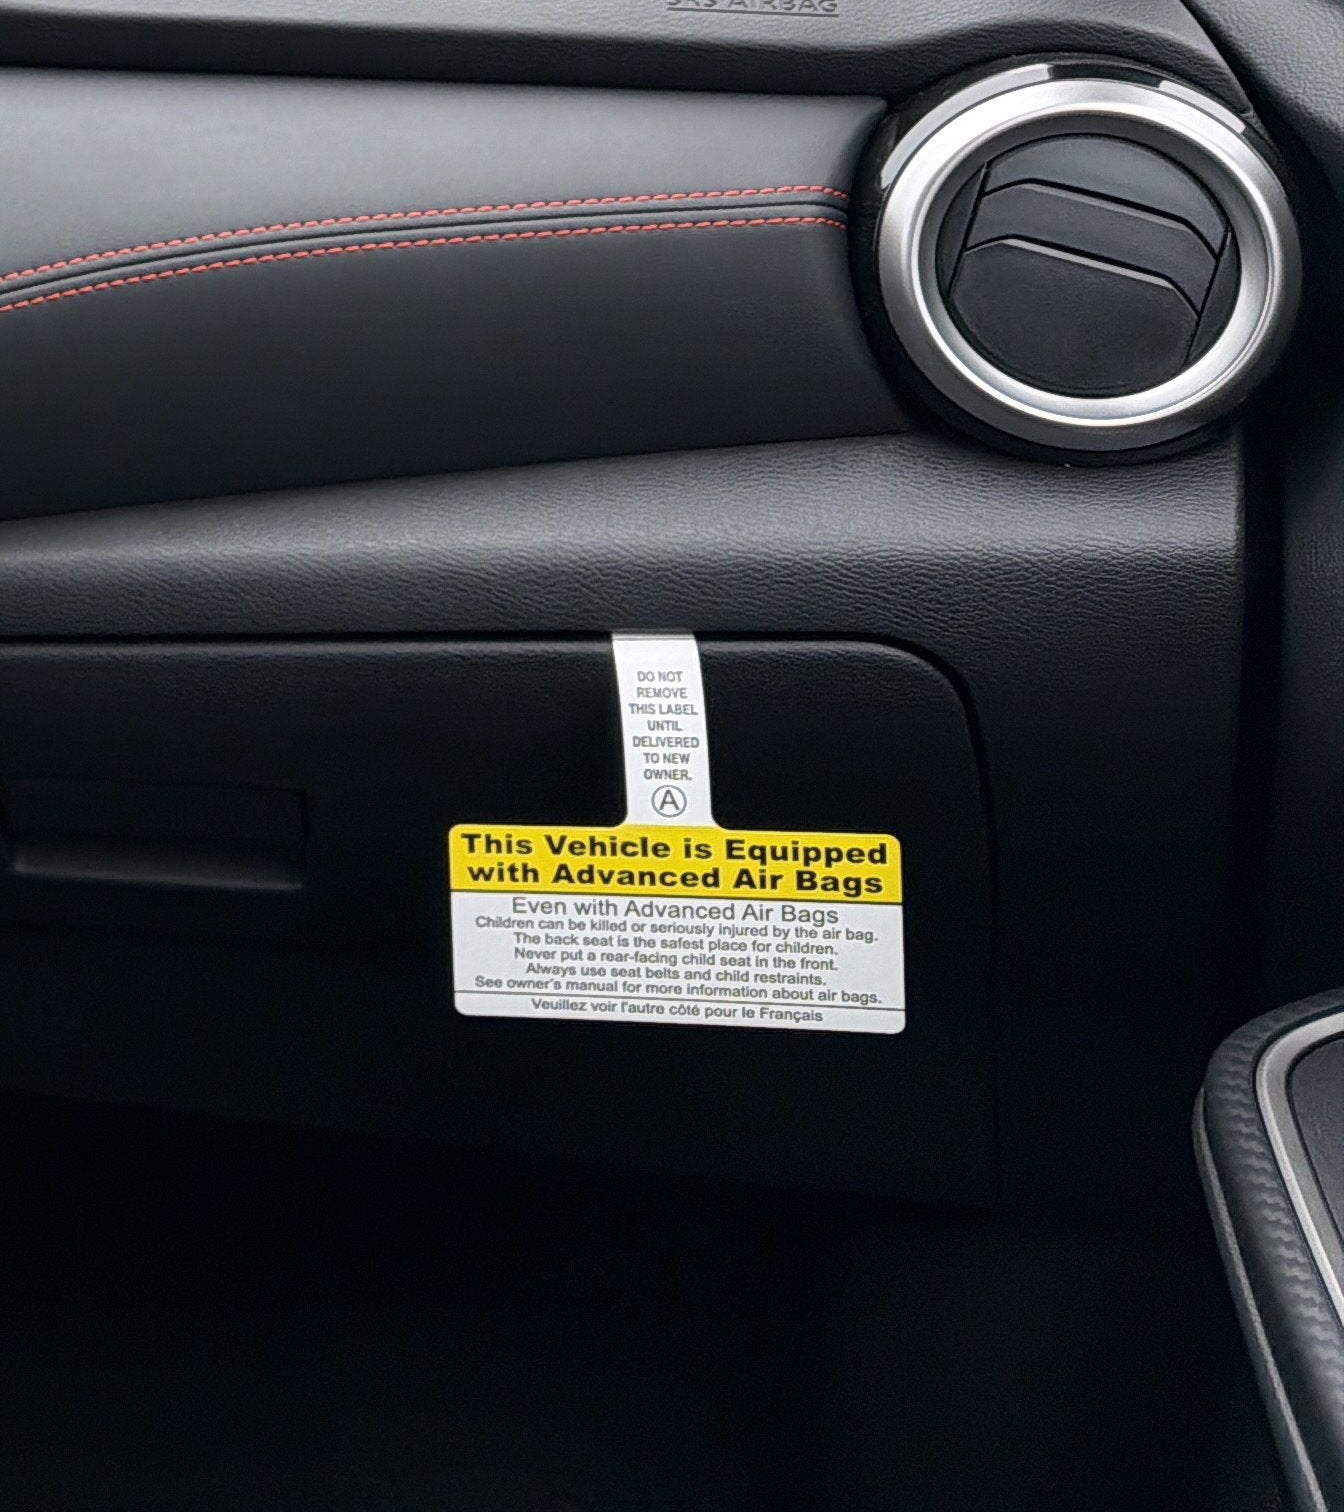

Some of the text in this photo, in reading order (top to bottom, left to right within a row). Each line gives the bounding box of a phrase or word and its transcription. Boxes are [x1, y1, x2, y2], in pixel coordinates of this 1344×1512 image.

[637, 671, 683, 683] DO NOT
[637, 687, 688, 699] REMOVE
[629, 703, 699, 715] THIS LABEL
[647, 720, 683, 731] UNTIL
[632, 736, 699, 748] DELIVERED
[643, 752, 690, 764] TO NEW
[643, 769, 693, 781] OWNER.
[659, 789, 680, 811] A
[461, 833, 887, 868] This Vehicle is Equipped
[467, 862, 883, 898] with Advanced Air Bags
[512, 897, 839, 928] Even with Advanced Air Bags
[475, 916, 879, 944] Children can be killed or seriously injured by the air bag.
[513, 931, 838, 955] The back seat is the safest place for children.
[514, 947, 839, 971] Never put a rear-facing child seat in the front.
[526, 962, 827, 987] Always use seat belts and child restraints.
[475, 975, 883, 1006] See owner's manual for more information about air bags.
[531, 998, 824, 1023] Veuillez voir l'autre côté pour le Français
